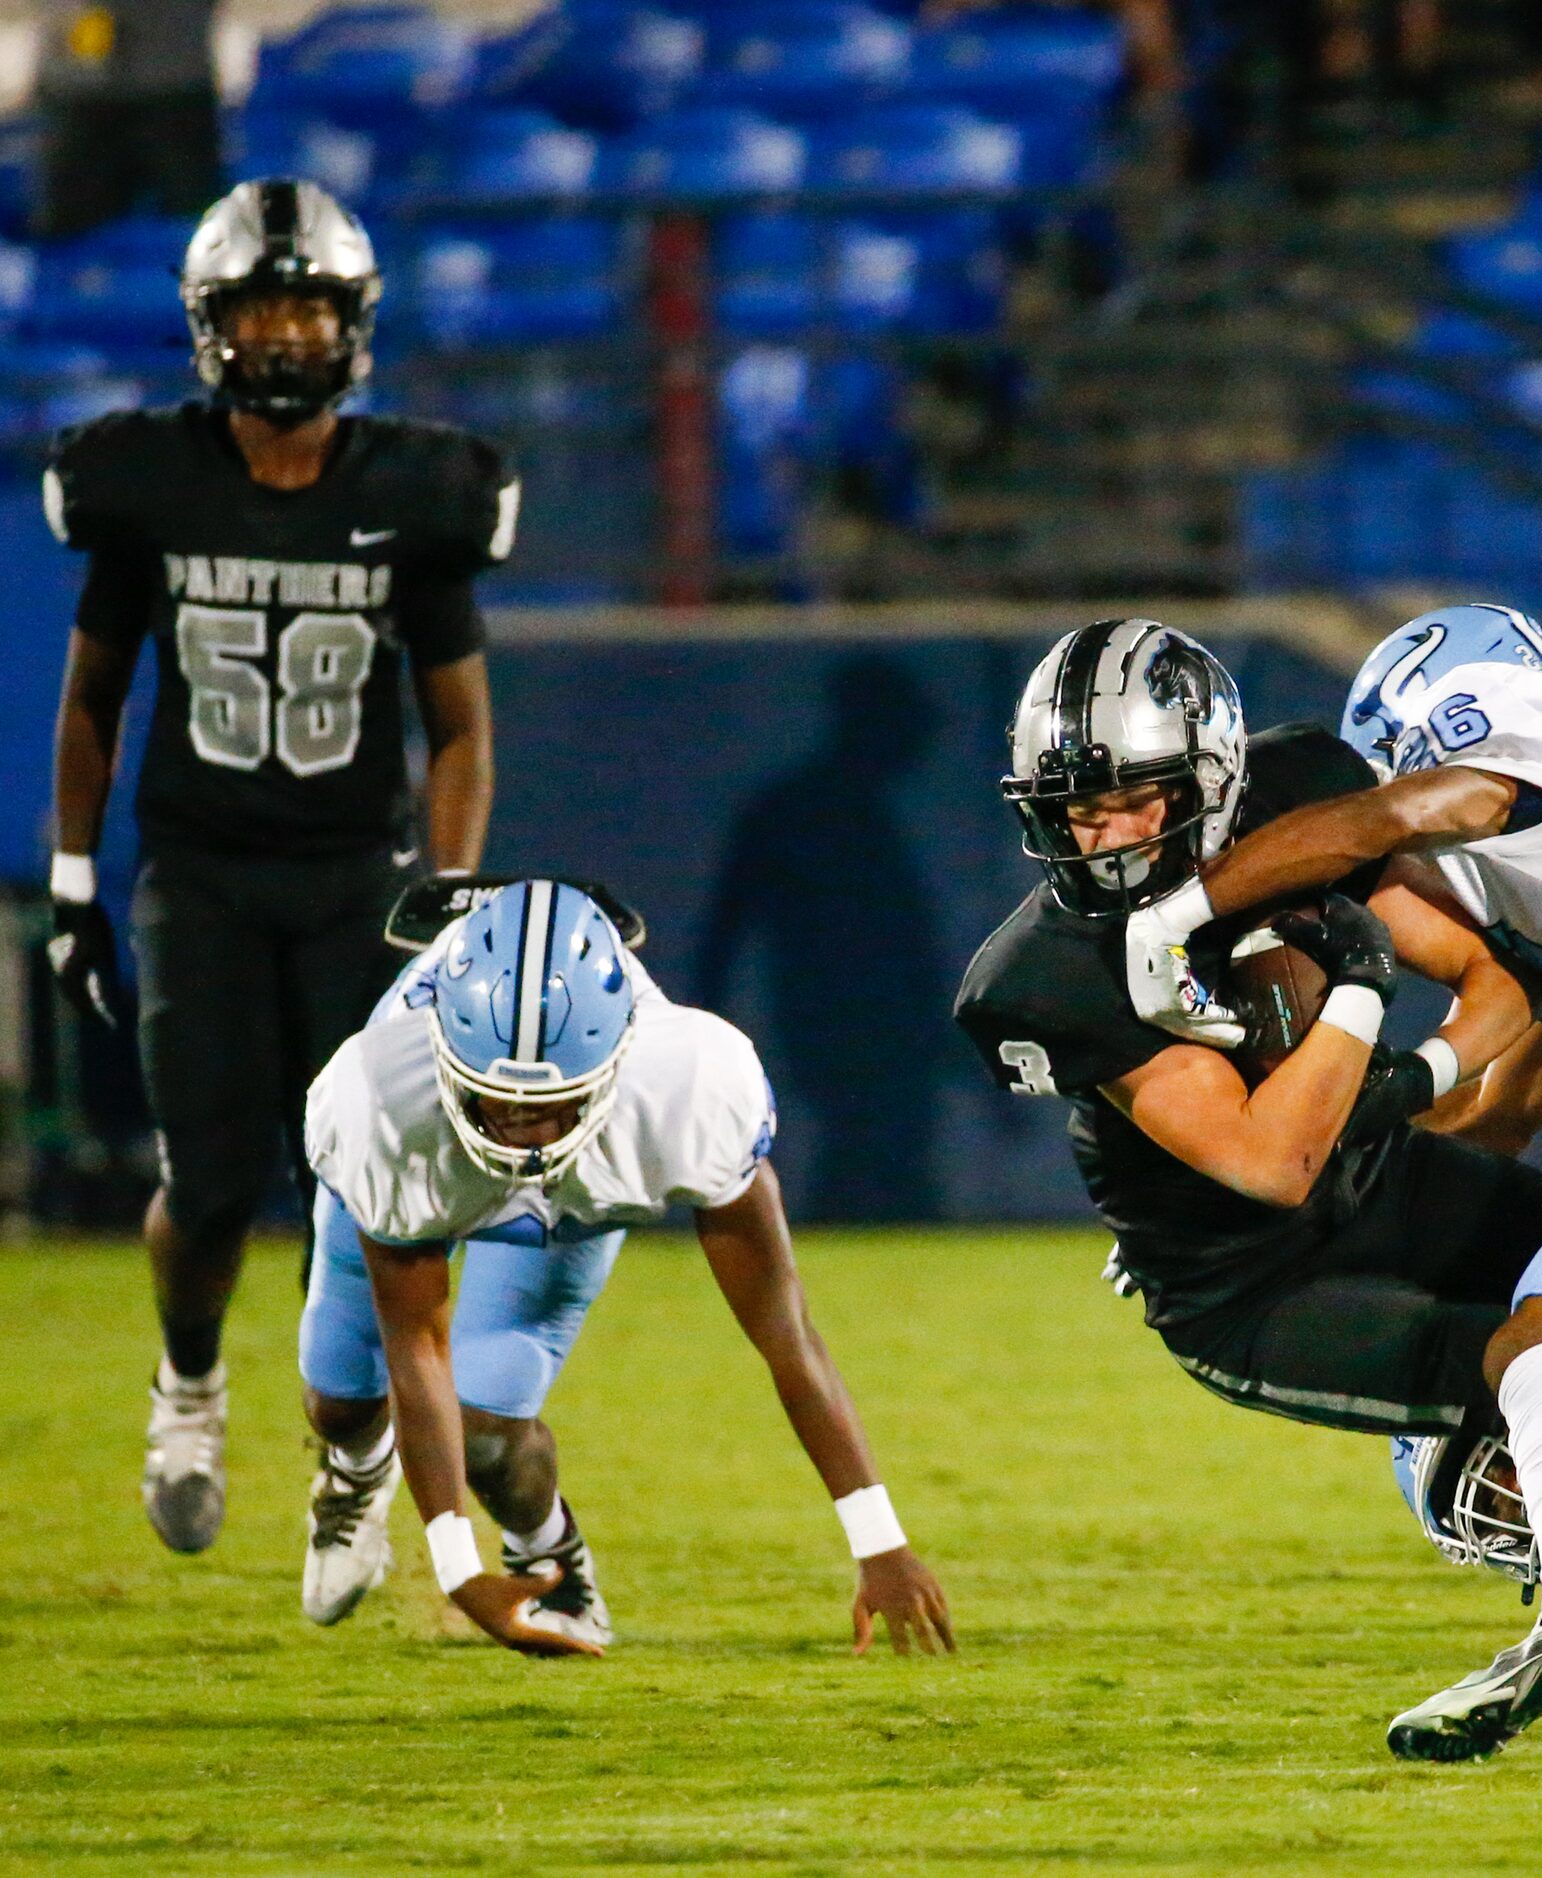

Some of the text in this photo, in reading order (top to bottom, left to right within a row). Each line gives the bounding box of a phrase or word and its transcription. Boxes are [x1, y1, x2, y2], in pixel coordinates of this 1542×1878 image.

[163, 553, 393, 609] PANTHERS
[176, 602, 377, 778] 58
[997, 1040, 1060, 1097] 3
